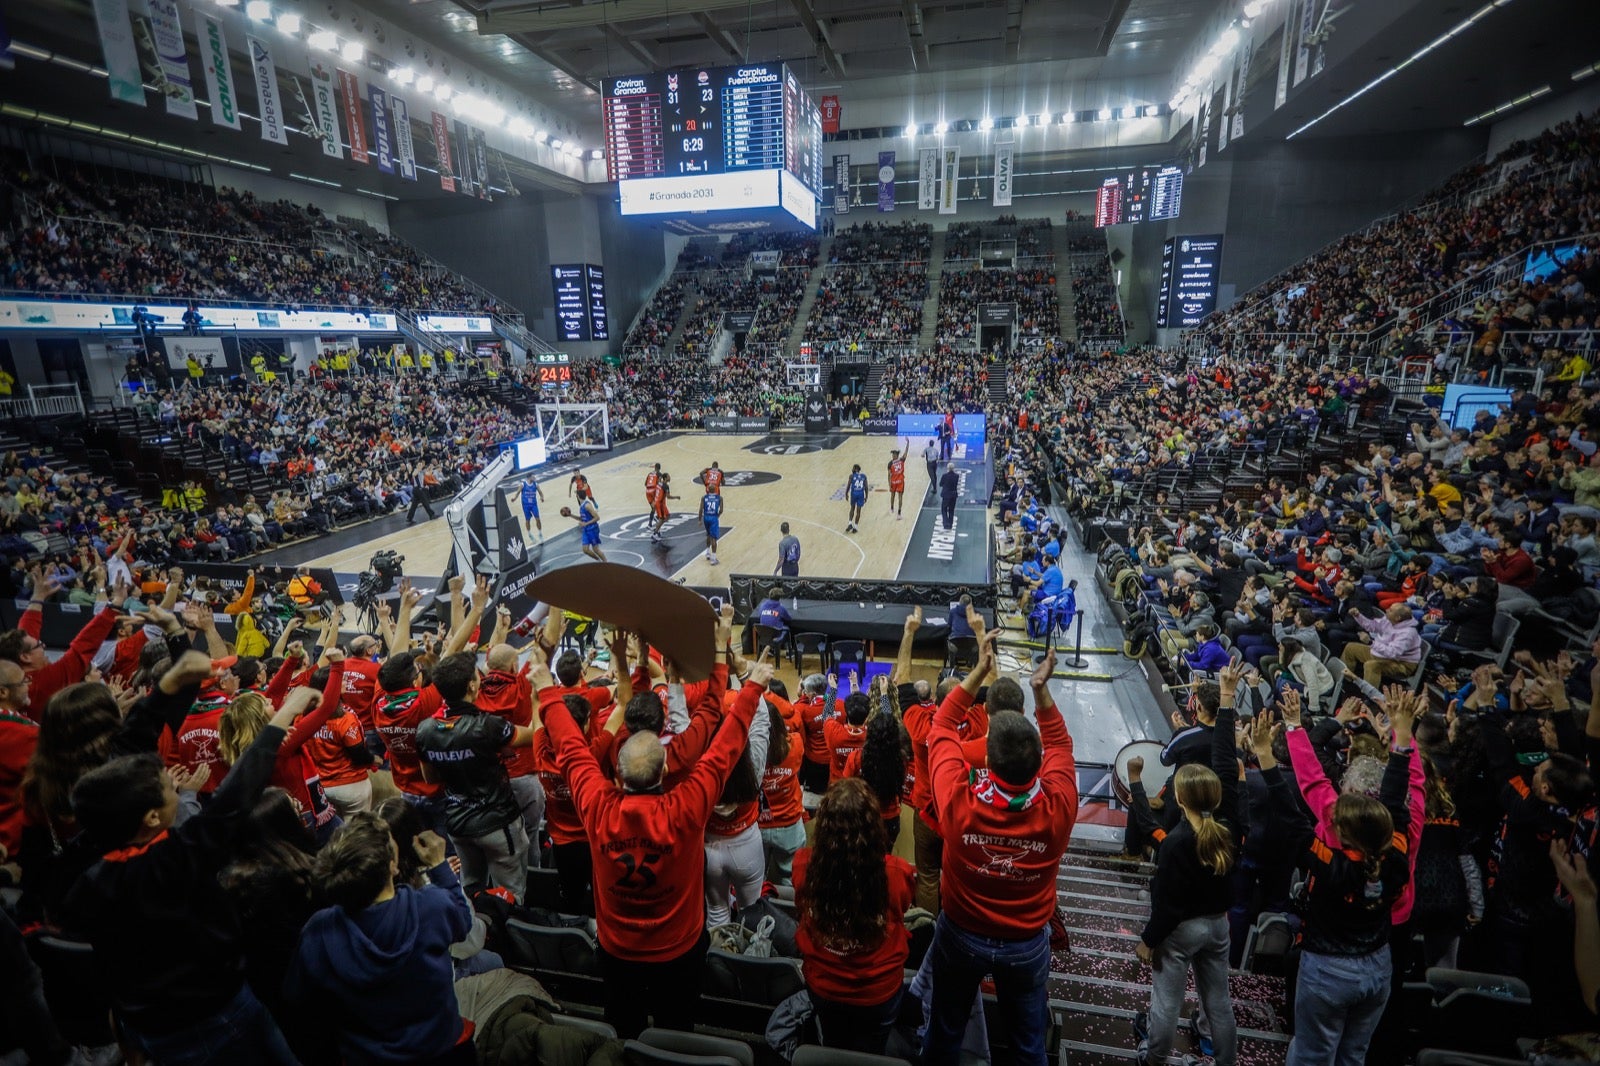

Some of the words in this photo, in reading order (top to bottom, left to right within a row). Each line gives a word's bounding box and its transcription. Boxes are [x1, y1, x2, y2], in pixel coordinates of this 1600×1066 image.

[207, 20, 235, 124] COVIRAN
[614, 87, 647, 95] Granada
[616, 80, 643, 88] Coviran
[260, 66, 279, 140] emasagra
[668, 92, 678, 103] 31
[702, 89, 712, 101] 23
[827, 107, 833, 118] 8
[317, 86, 337, 154] fertisac
[374, 93, 391, 169] PULEVA
[683, 138, 704, 151] 6:29
[1000, 157, 1008, 191] OLIVA
[649, 189, 690, 201] #Granada
[693, 187, 713, 199] 2031
[540, 367, 558, 380] 24
[560, 366, 571, 380] 24
[864, 418, 897, 427] endesa
[427, 749, 475, 761] PULEVA
[962, 833, 1006, 846] FRENTE
[615, 853, 660, 888] 25
